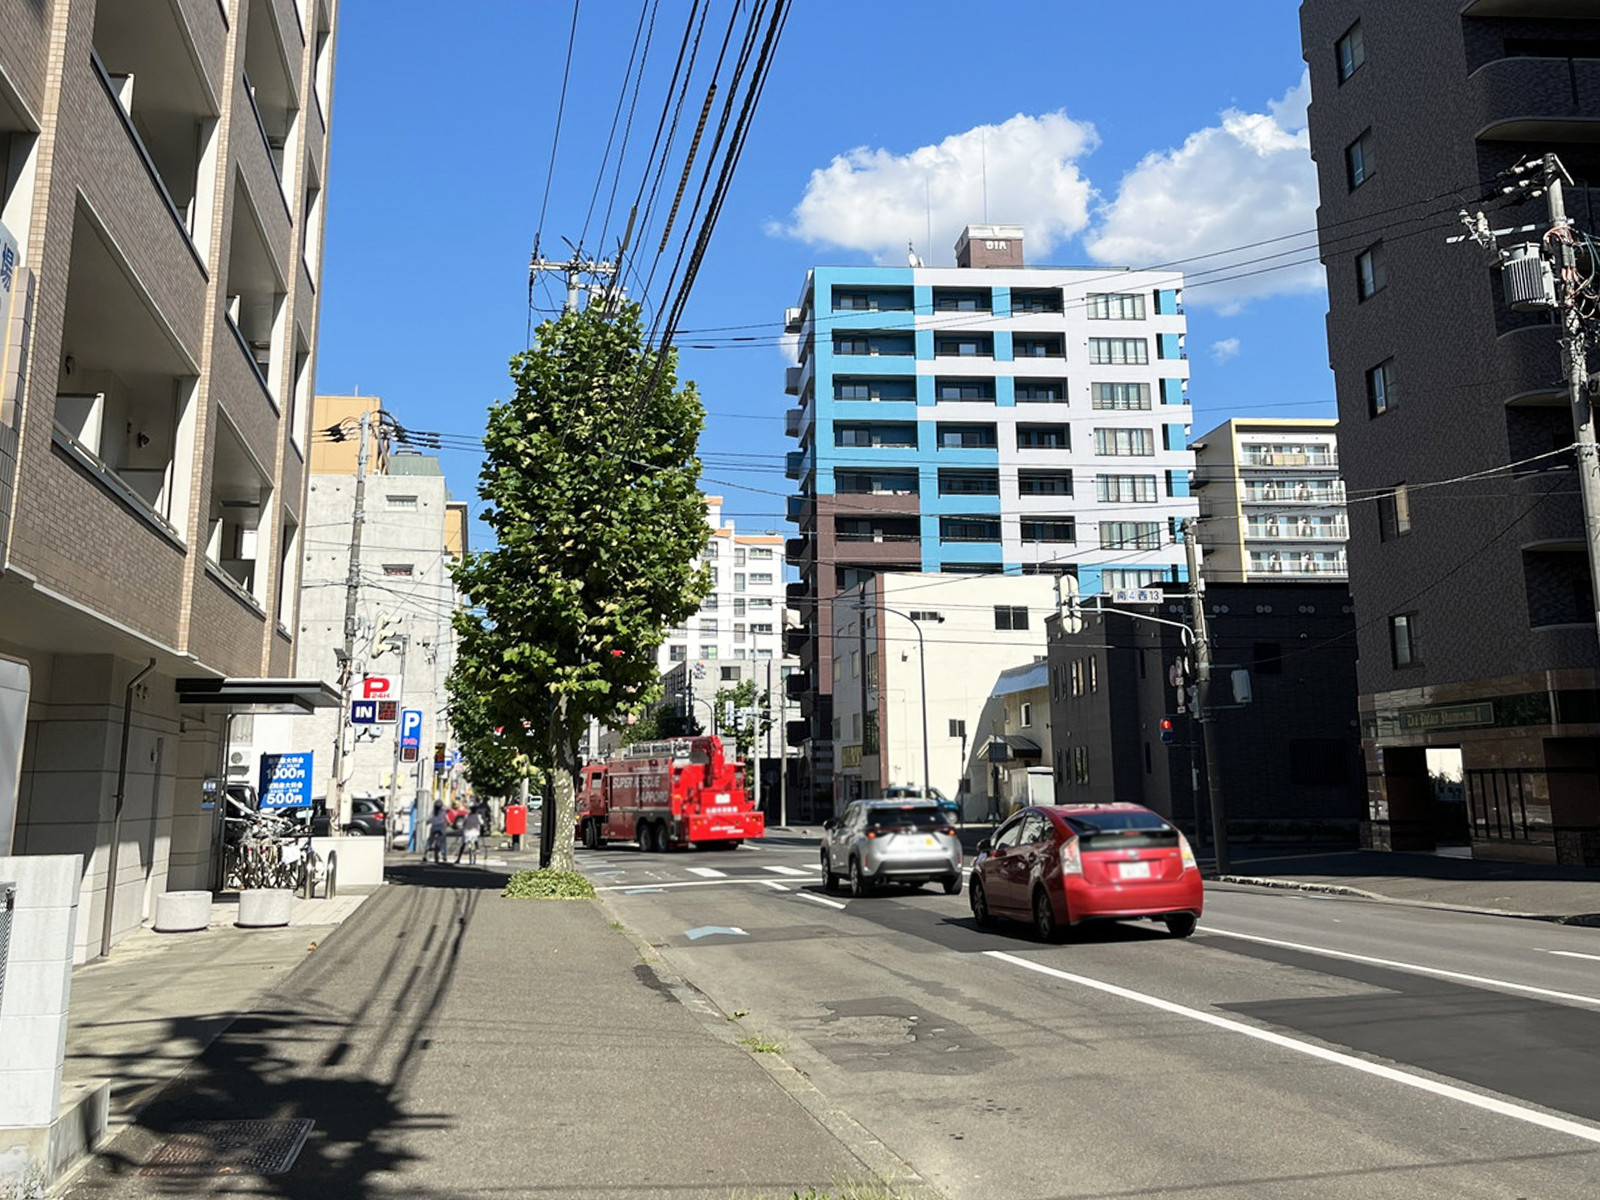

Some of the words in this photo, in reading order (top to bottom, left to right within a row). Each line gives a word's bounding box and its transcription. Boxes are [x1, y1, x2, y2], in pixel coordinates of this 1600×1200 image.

[363, 677, 390, 699] P
[355, 706, 373, 719] IN
[404, 712, 420, 736] P
[612, 776, 633, 789] SUPER
[266, 793, 303, 805] 500円
